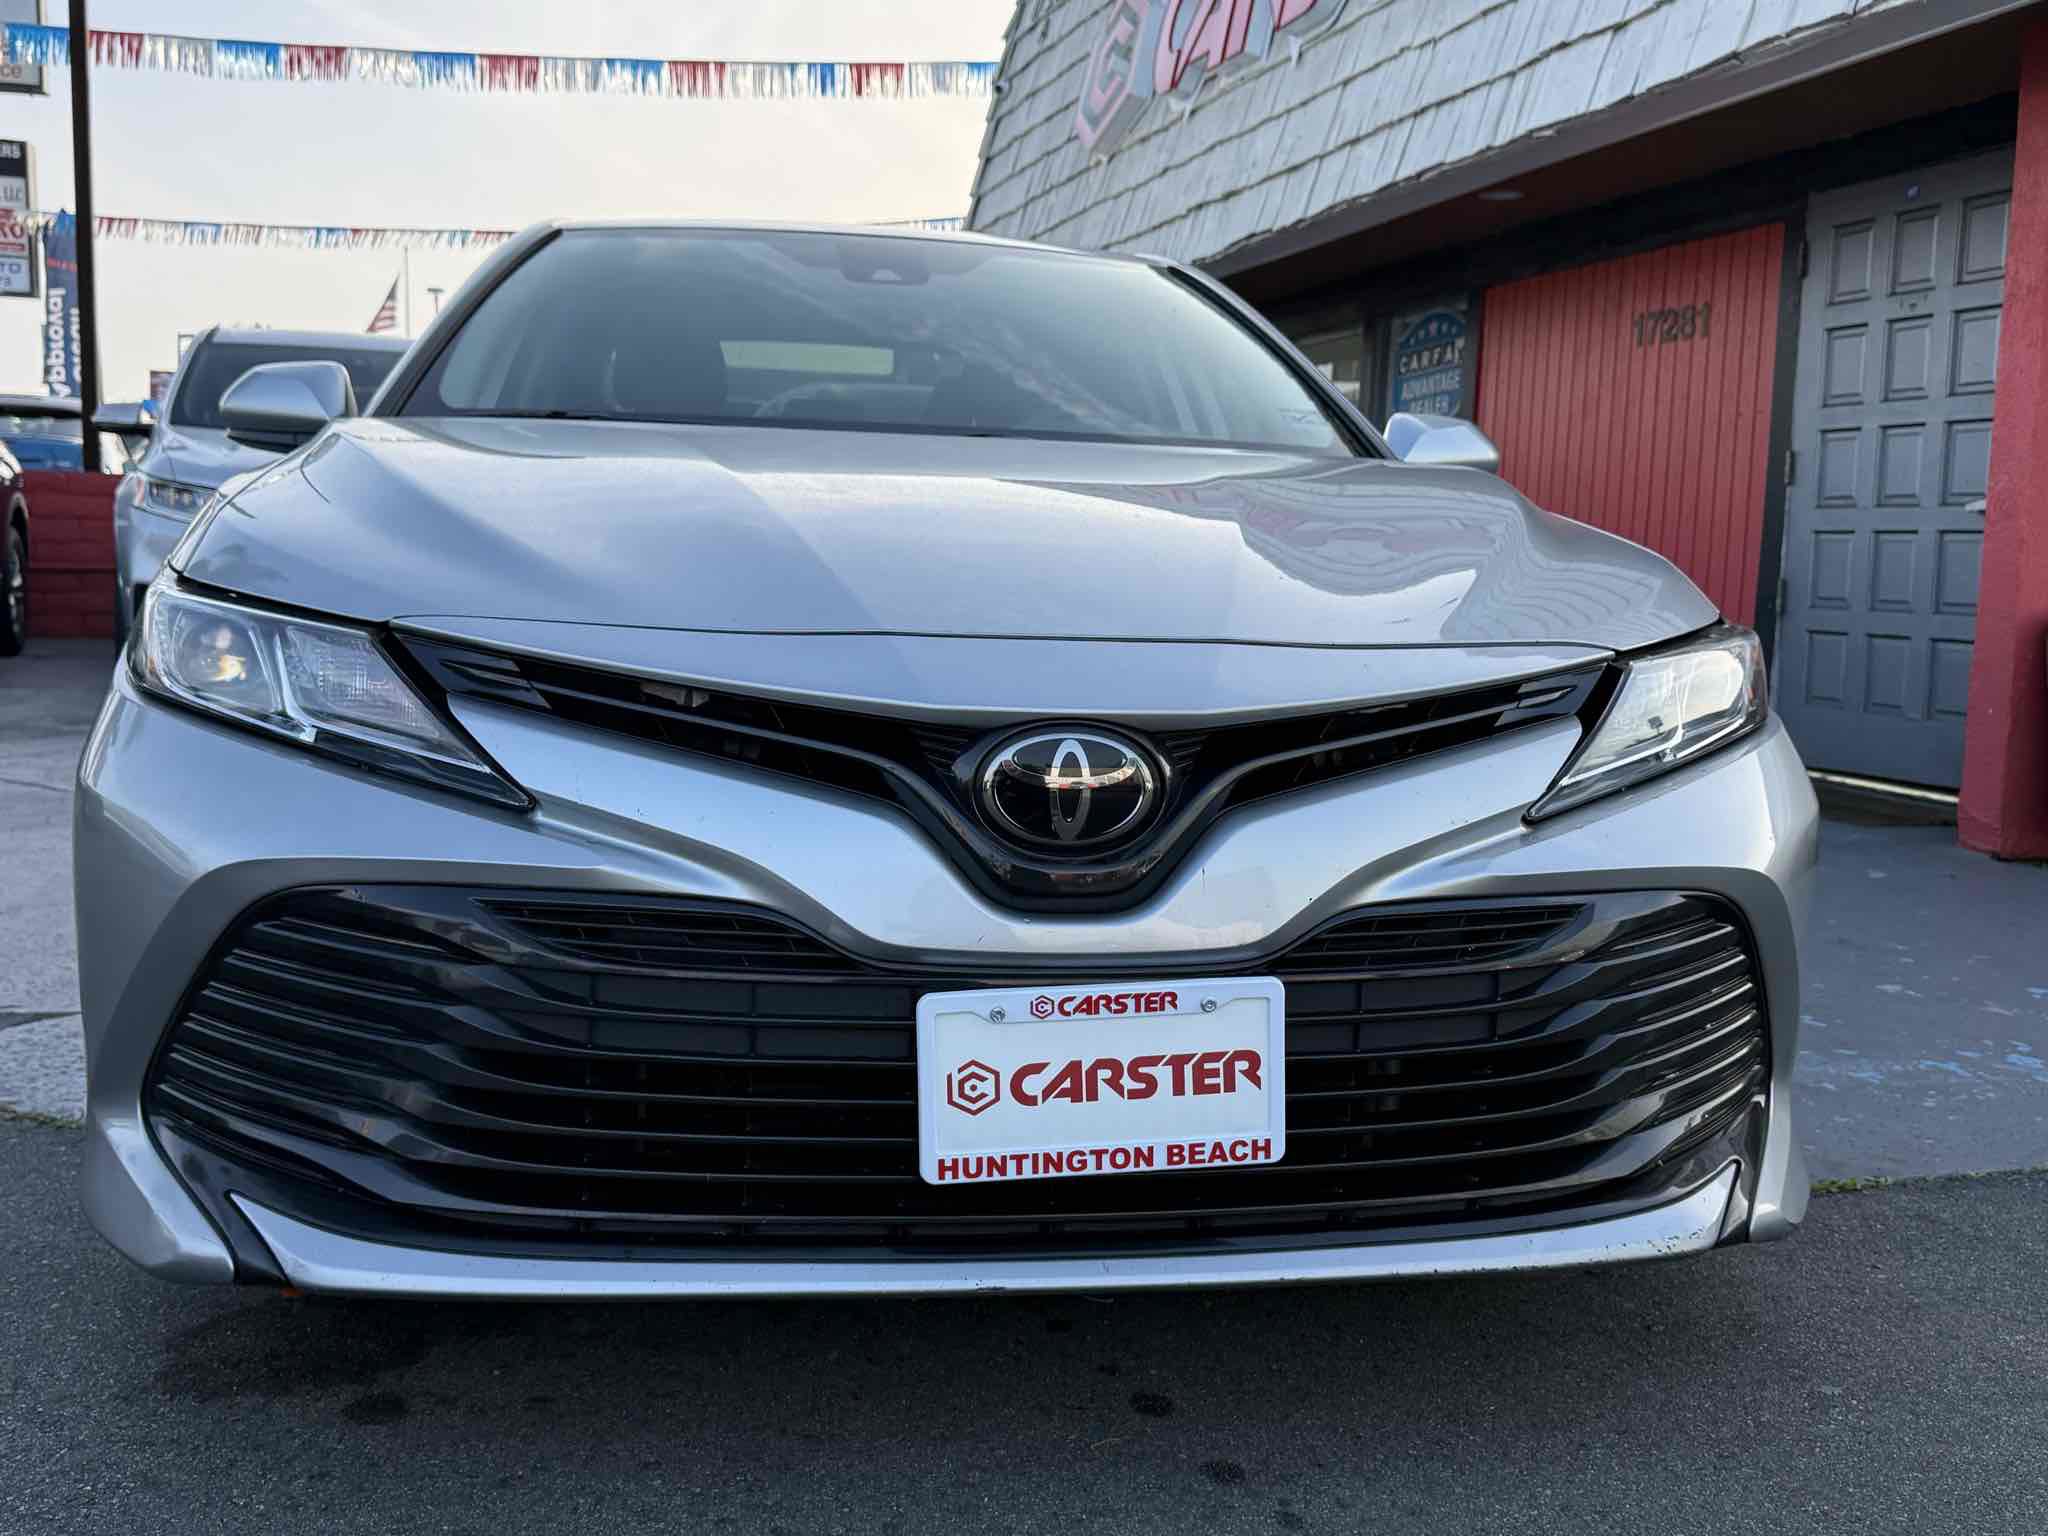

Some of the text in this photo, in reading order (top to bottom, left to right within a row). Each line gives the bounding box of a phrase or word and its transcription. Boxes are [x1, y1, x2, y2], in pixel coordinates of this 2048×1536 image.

[1633, 303, 1709, 347] 17281
[1401, 371, 1462, 401] ADVANTAGE
[1058, 991, 1178, 1017] CARSTER
[1009, 1050, 1262, 1107] CARSTER
[937, 1138, 1272, 1181] HUNTINGTON BEACH
